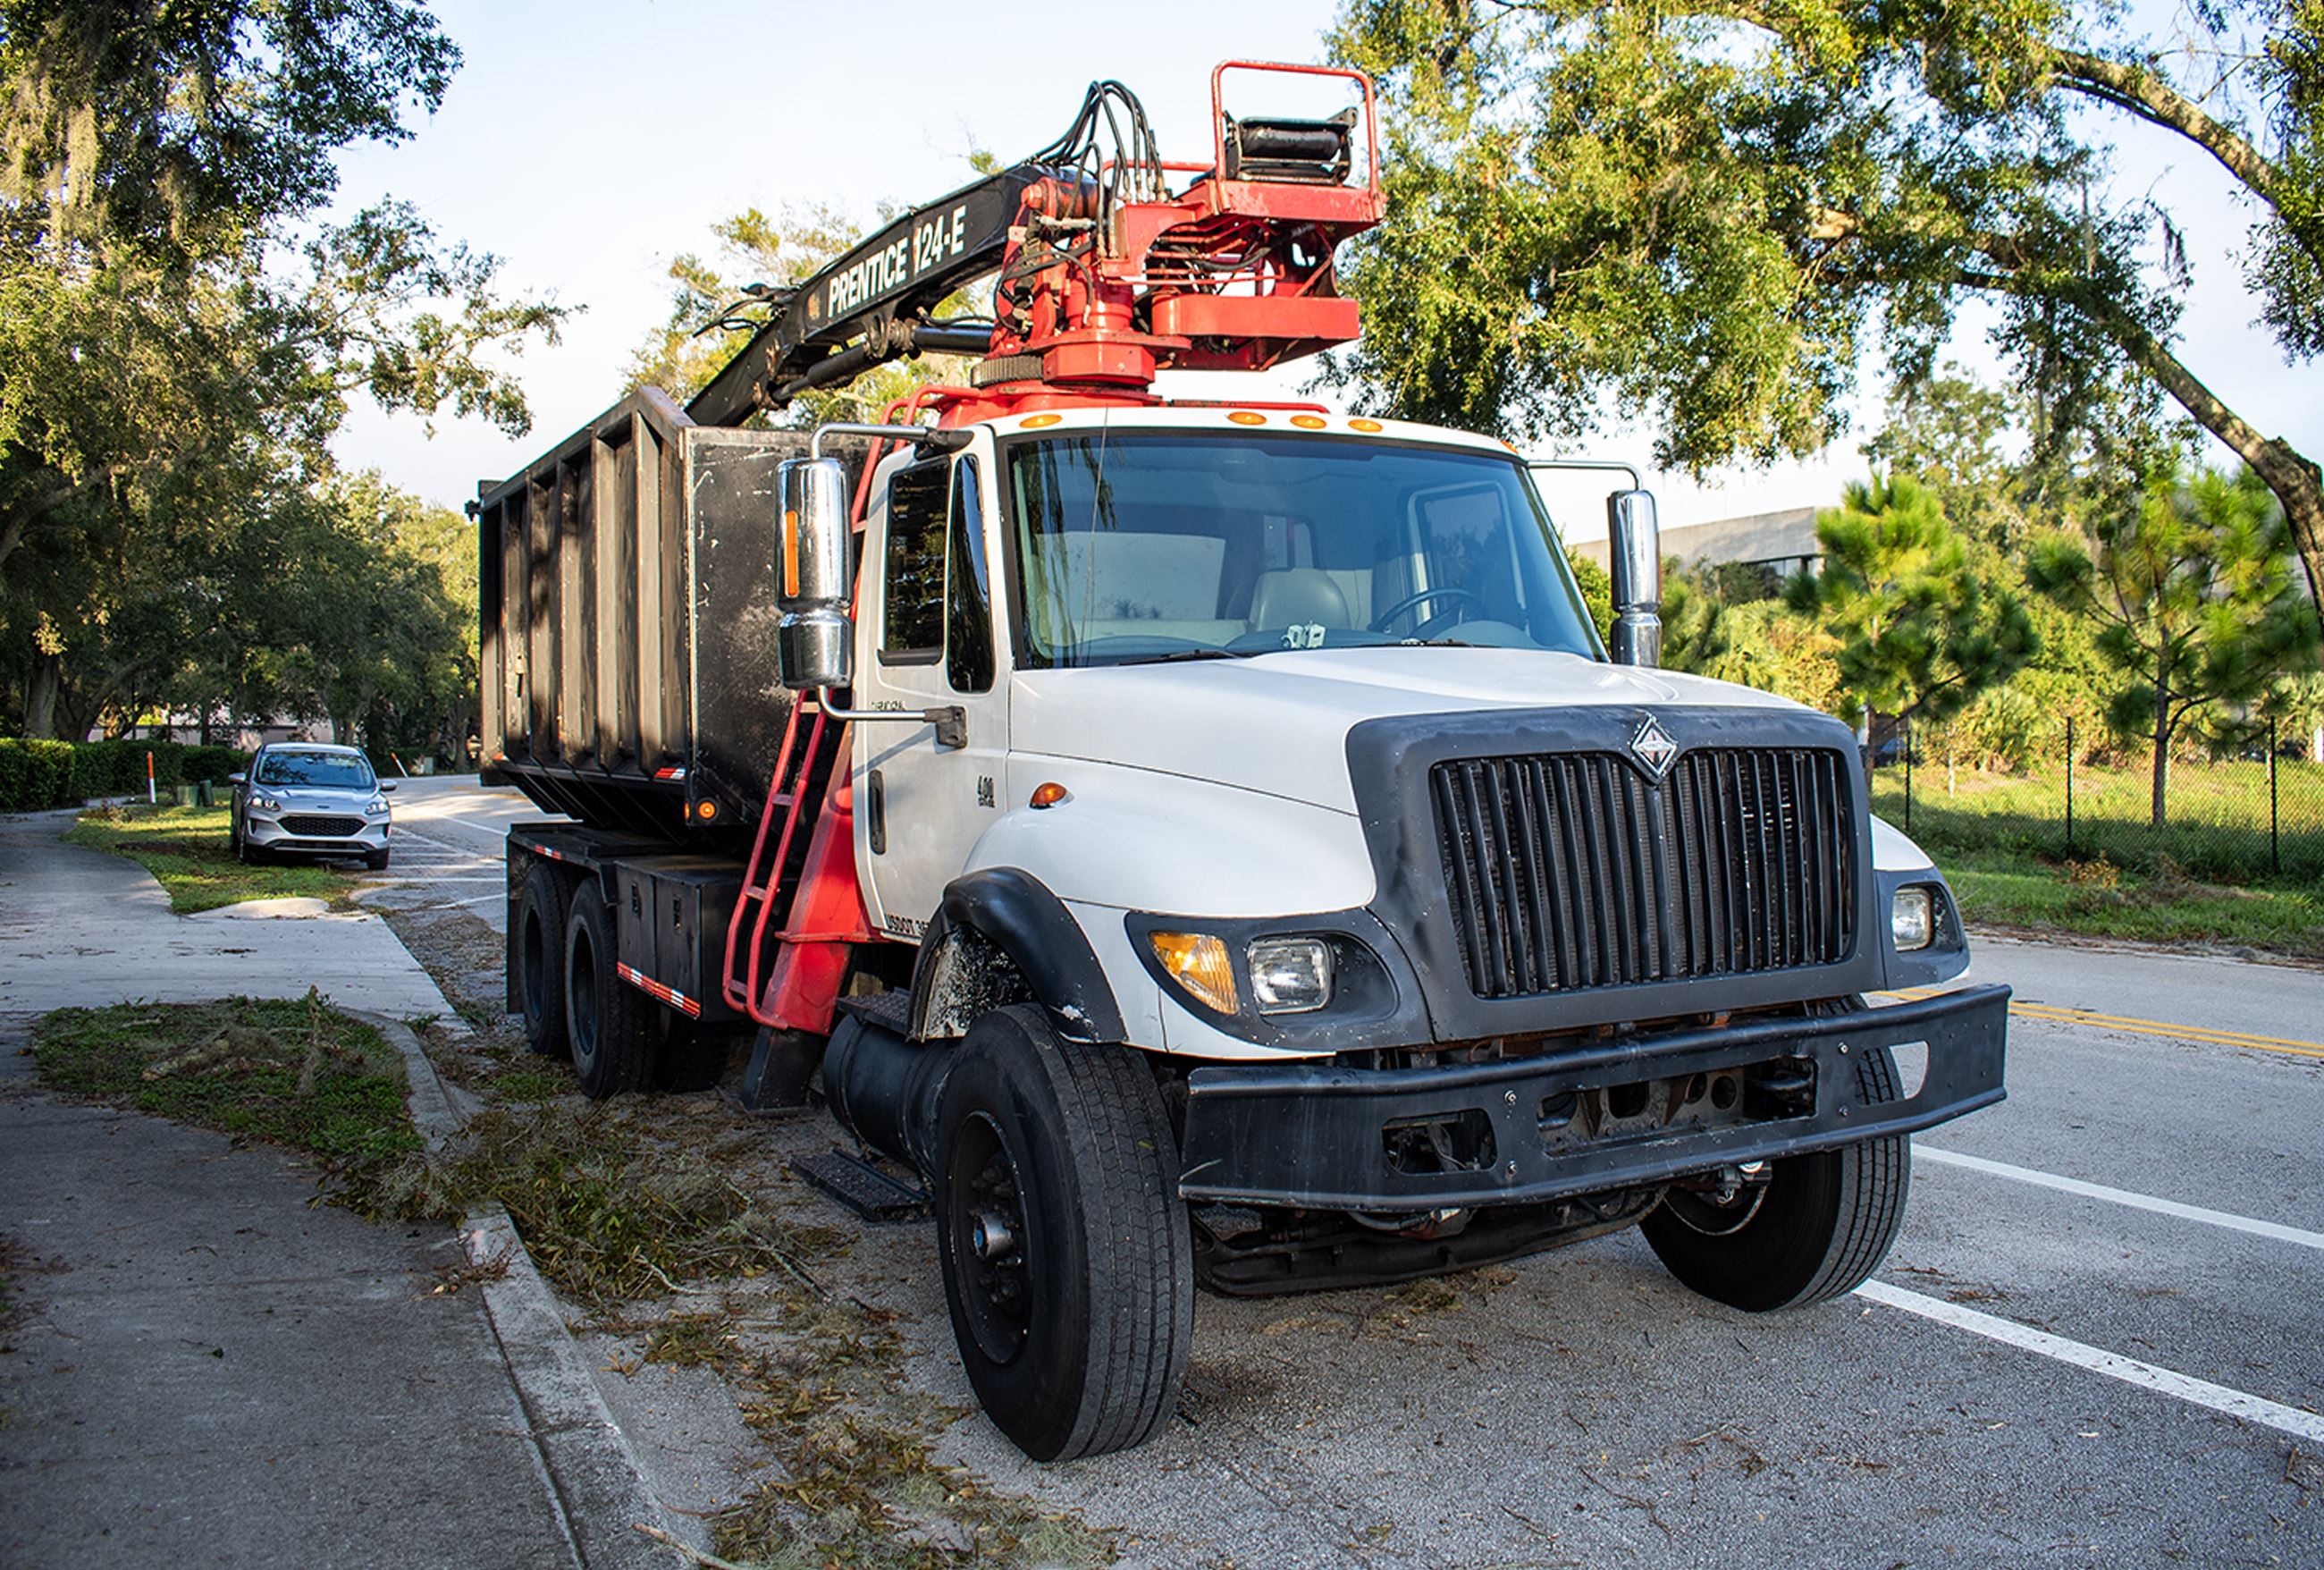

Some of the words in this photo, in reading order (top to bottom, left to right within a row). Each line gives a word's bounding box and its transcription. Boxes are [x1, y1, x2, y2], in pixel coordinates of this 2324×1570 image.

[828, 236, 909, 318] PRENTICE
[913, 204, 967, 274] 124-E
[884, 912, 915, 935] USDOT
